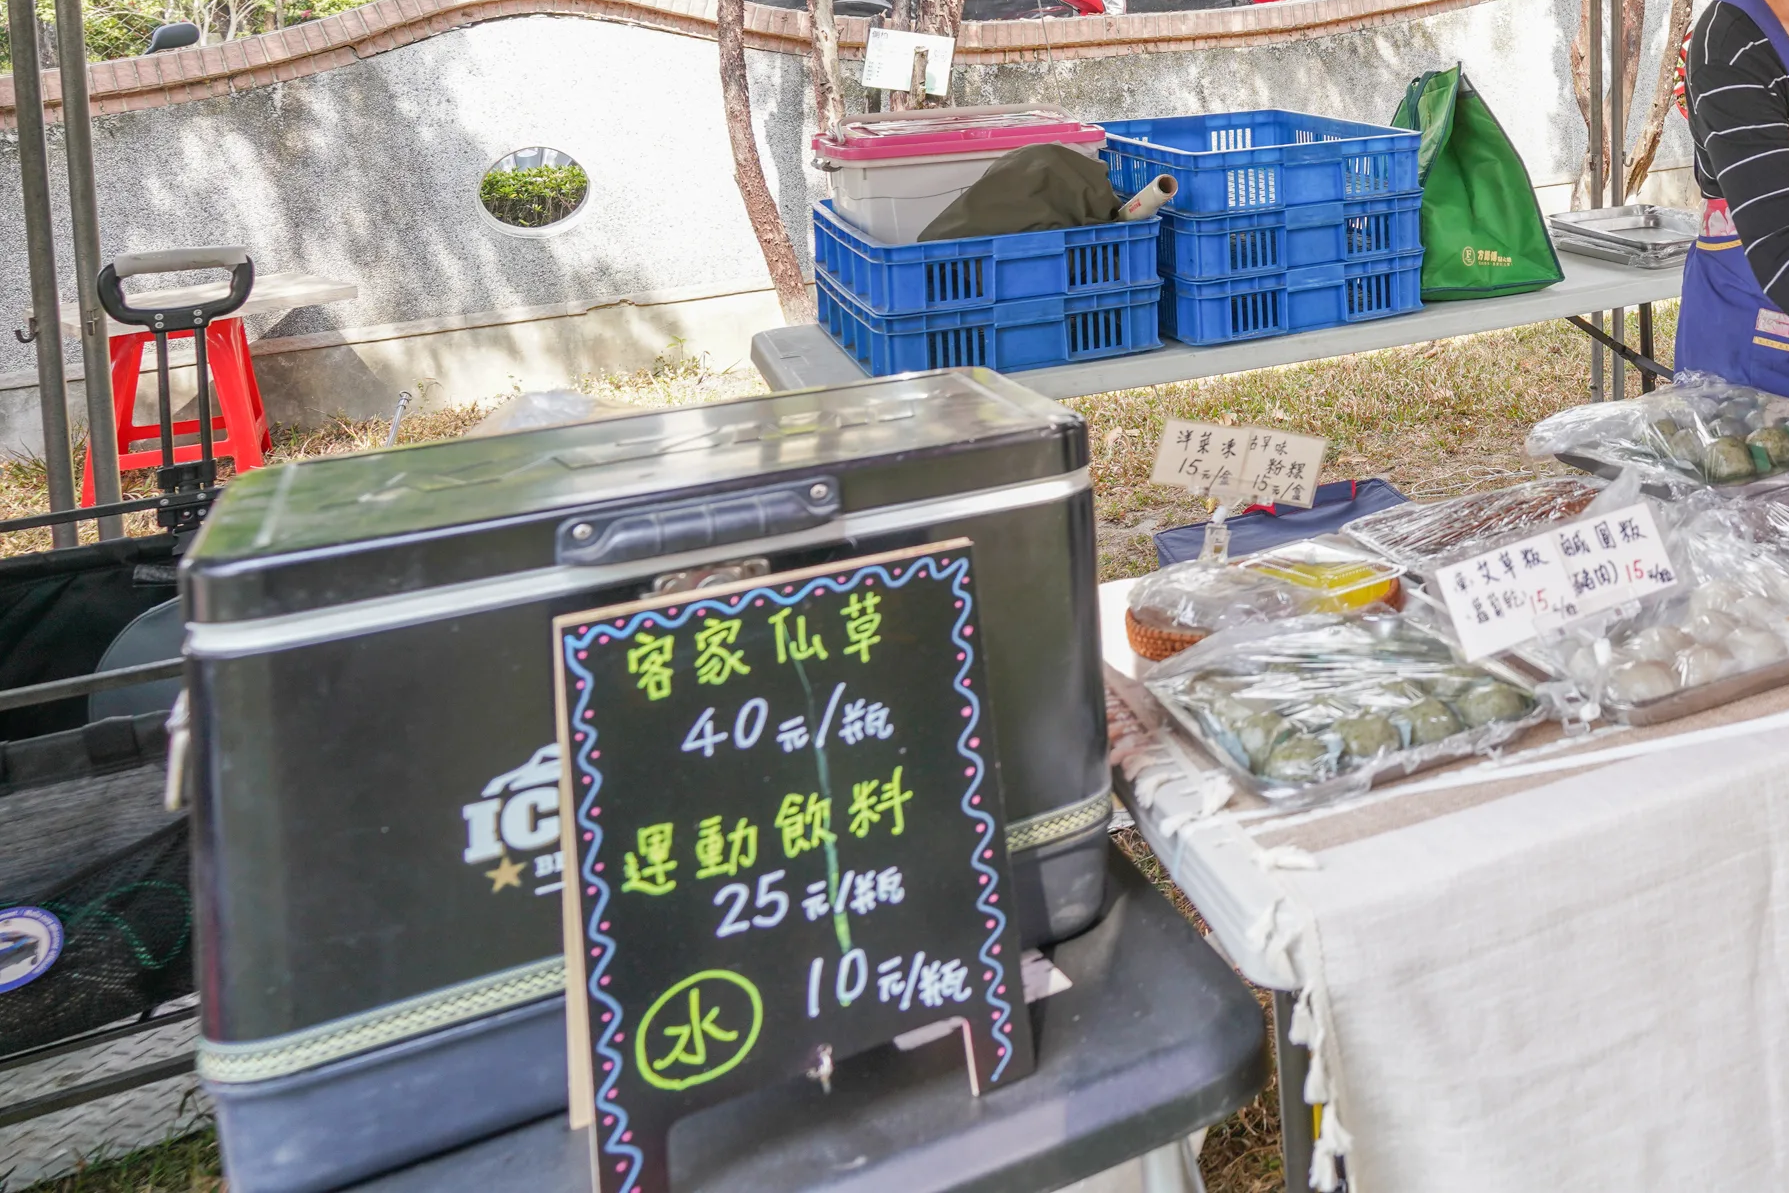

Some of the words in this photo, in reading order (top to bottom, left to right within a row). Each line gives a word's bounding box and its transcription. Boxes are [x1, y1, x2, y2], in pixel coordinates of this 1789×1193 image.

[627, 592, 882, 701] 客家仙草
[681, 682, 894, 757] 40元/瓶
[622, 765, 914, 896] 運動飲料
[713, 866, 906, 938] 25元/瓶
[653, 987, 739, 1071] 水
[807, 948, 972, 1018] 10元/瓶
